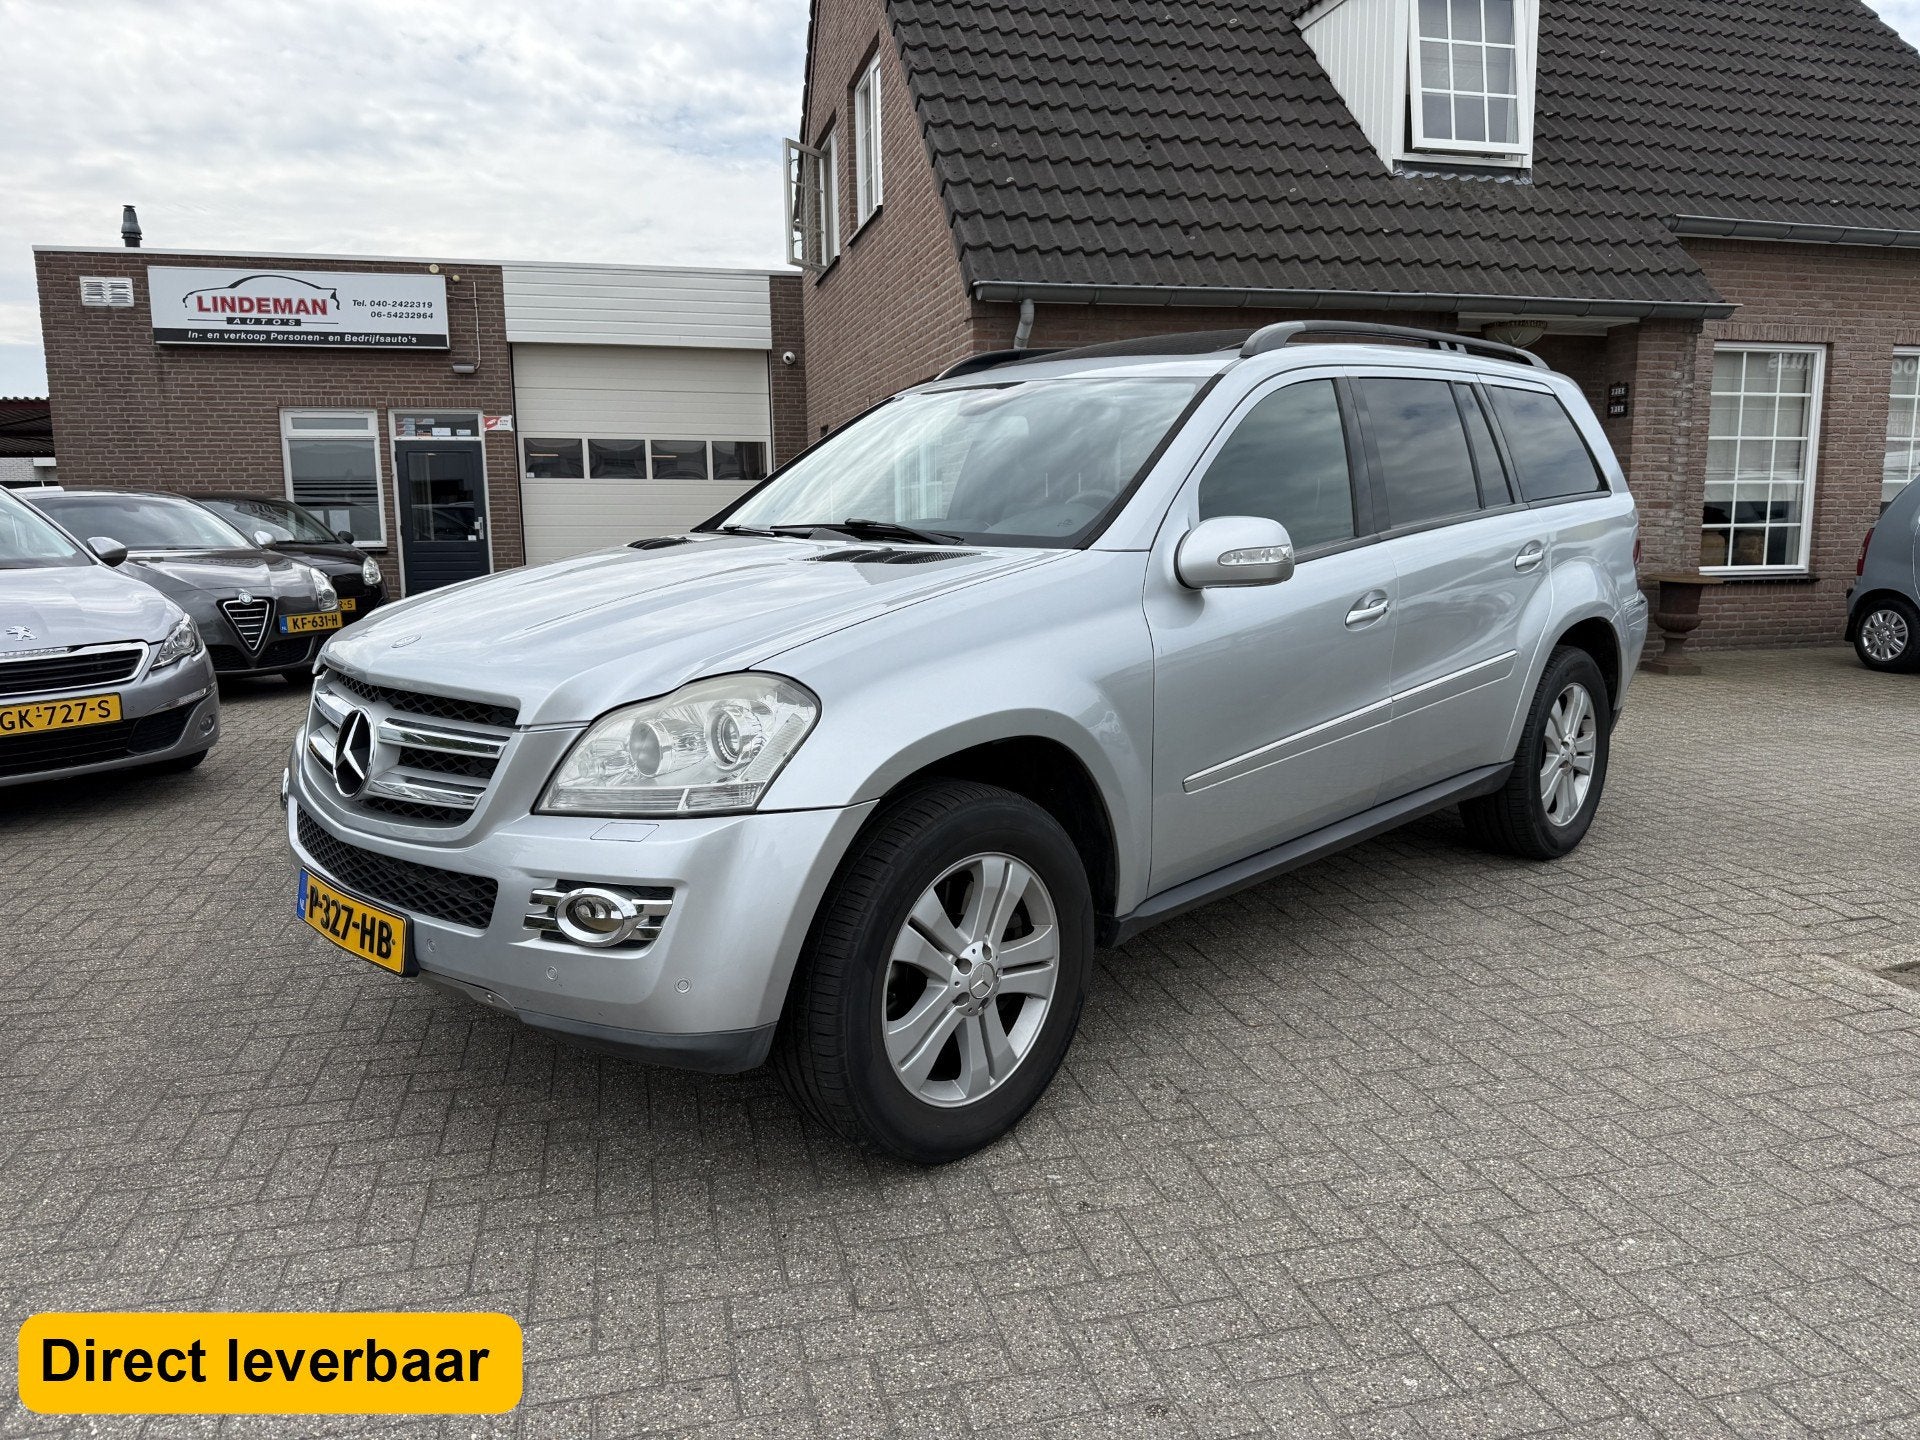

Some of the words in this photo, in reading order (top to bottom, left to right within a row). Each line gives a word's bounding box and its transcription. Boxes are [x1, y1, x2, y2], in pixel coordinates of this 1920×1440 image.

[196, 295, 328, 316] LINDEMAN
[352, 299, 367, 307] Tel.
[369, 300, 433, 309] 040-2422319
[233, 318, 296, 326] AUTO'S
[370, 311, 434, 319] 06-54232964
[188, 330, 203, 339] In-
[223, 331, 267, 342] verkoop
[270, 332, 324, 342] Personen-
[328, 334, 341, 342] en
[344, 333, 417, 344] Bedrijfsauto's
[292, 614, 338, 630] KF-631-H
[308, 884, 393, 960] P-327-HB
